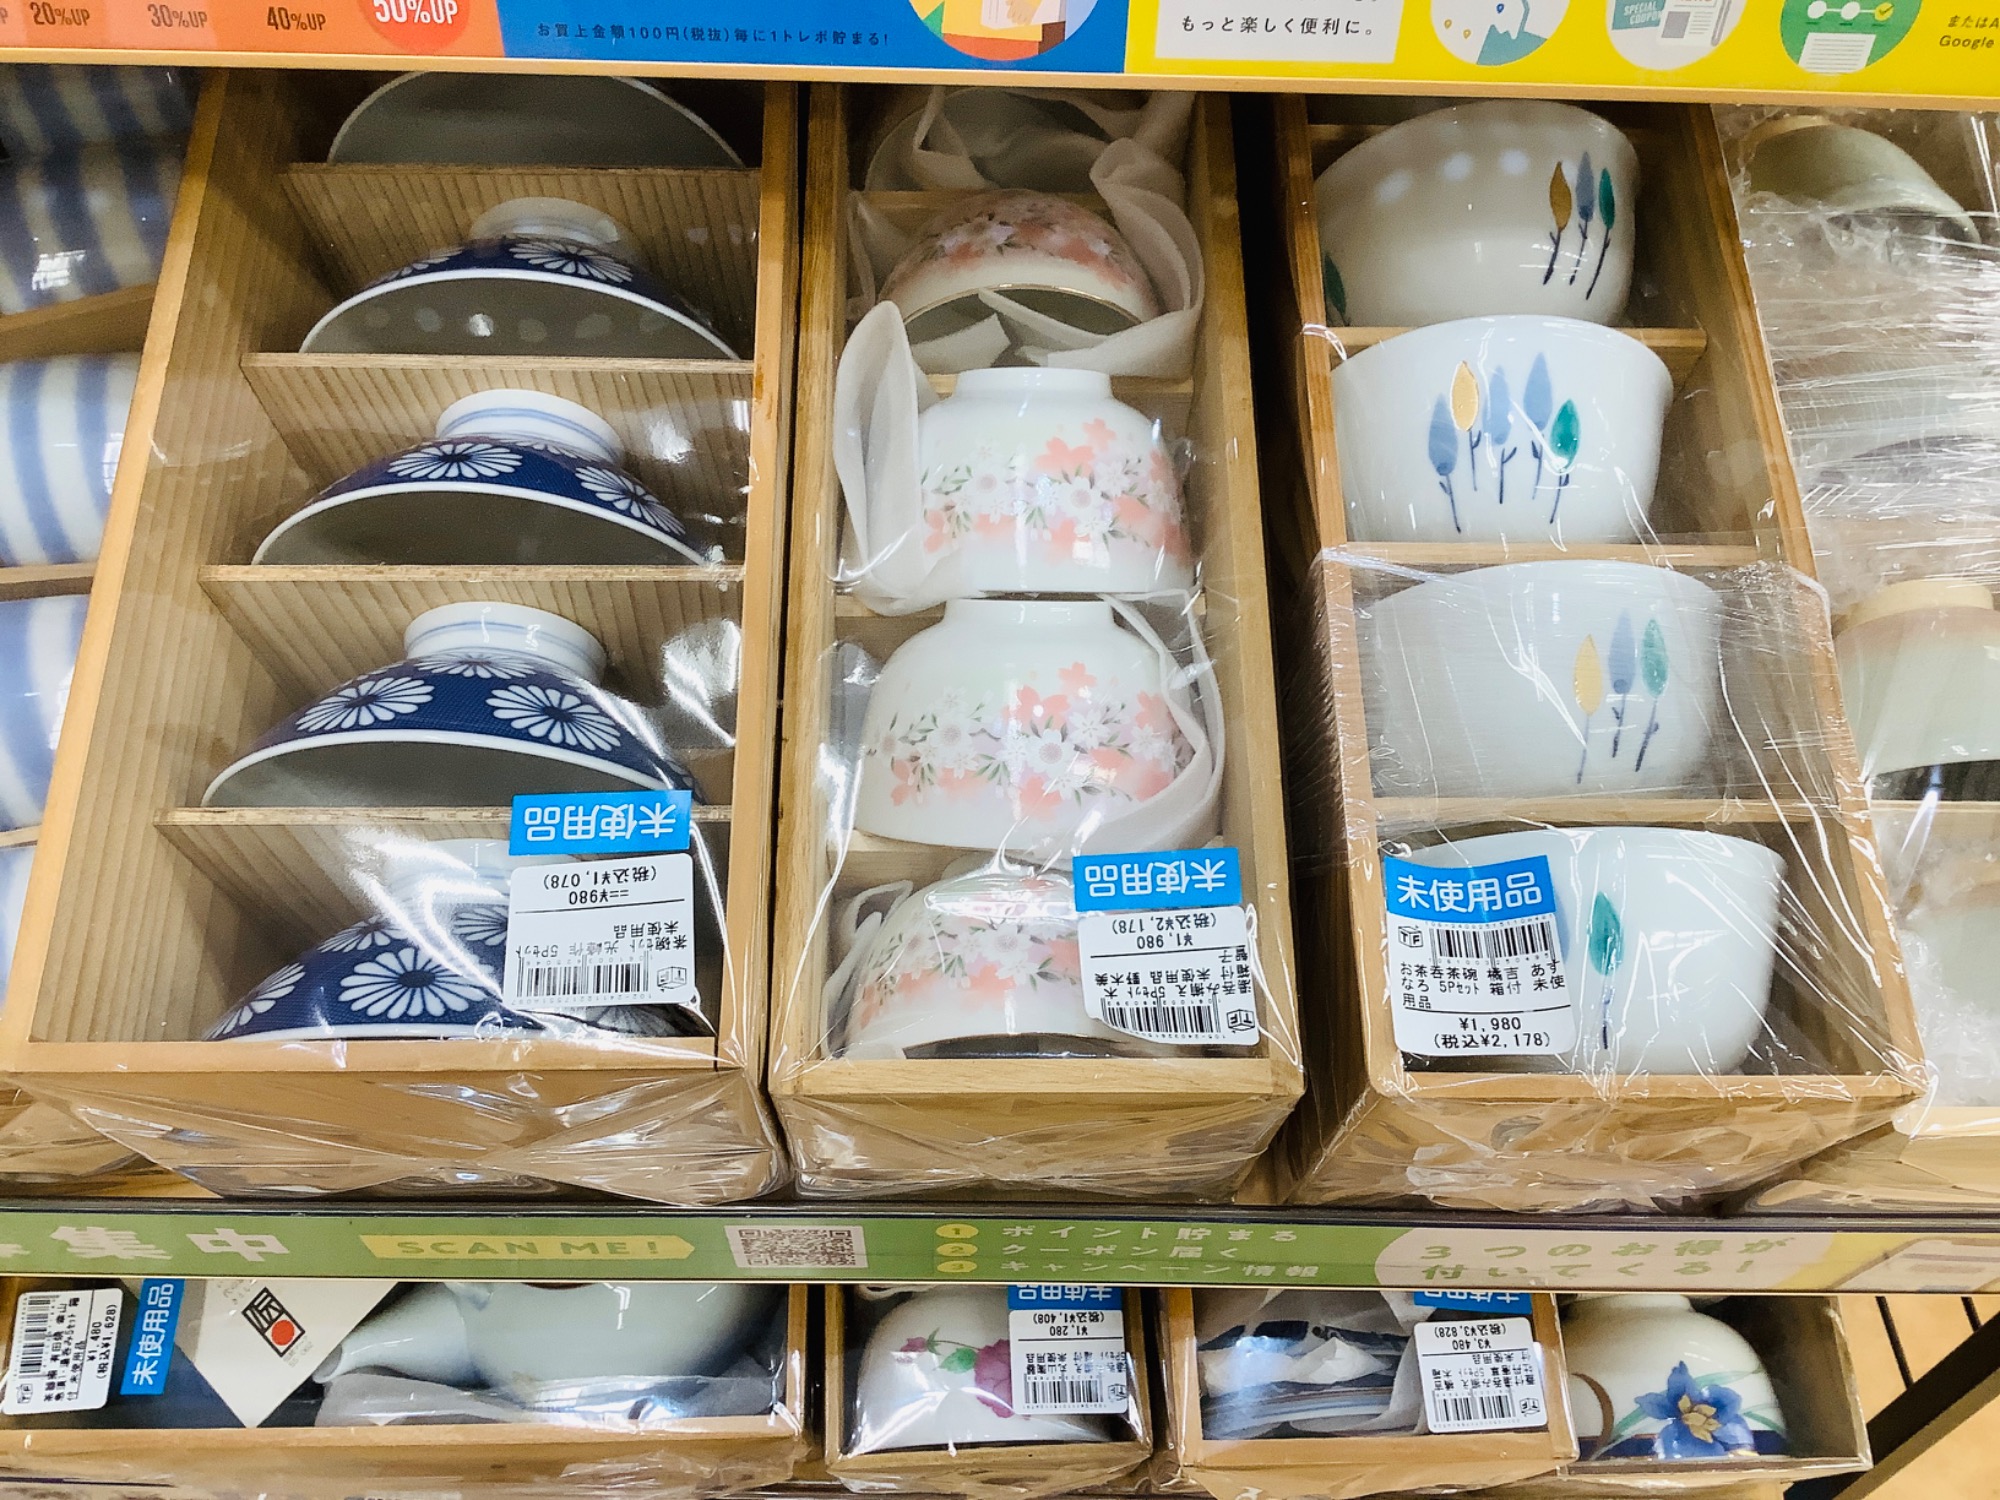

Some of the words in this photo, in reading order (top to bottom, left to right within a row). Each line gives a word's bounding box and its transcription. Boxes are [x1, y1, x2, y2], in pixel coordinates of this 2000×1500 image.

[30, 2, 90, 26] 20%UP
[147, 4, 208, 28] 30%UP
[266, 6, 327, 31] 40%UP
[373, 0, 458, 24] 50%UP
[1182, 16, 1373, 36] もっと楽しく便利に。
[1939, 35, 1994, 50] Google
[523, 802, 676, 841] 未使用品
[543, 866, 657, 889] (税込¥1,078)
[1084, 859, 1227, 897] 未使用品
[1397, 872, 1543, 912] 未使用品
[613, 921, 678, 938] 未使用品
[1112, 913, 1217, 934] (税込¥2,178)
[1136, 933, 1193, 949] ¥1,980
[1150, 968, 1210, 984] 未使用品
[1533, 976, 1565, 991] 未使
[1403, 994, 1431, 1009] 用品
[1459, 1017, 1521, 1031] ¥1,980
[1434, 1032, 1551, 1049] (税込¥2,178)
[1002, 1225, 1298, 1242] ポイント貯まる
[397, 1241, 539, 1255] SCAN
[1002, 1243, 1239, 1258] クーポン届く
[1420, 1237, 1796, 1259] 3つのお得が
[1000, 1261, 1321, 1278] キャンペーン情報
[1033, 1312, 1104, 1324] (税込¥1,408)
[132, 1283, 174, 1386] 未使用品
[1049, 1326, 1088, 1335] ¥1,280
[1434, 1324, 1506, 1338] (税込¥3,828)
[87, 1322, 102, 1361] ¥1,480
[96, 1304, 117, 1380] (税込¥1,628)
[1452, 1338, 1491, 1349] ¥3,480
[1026, 1353, 1067, 1362] 未使用品
